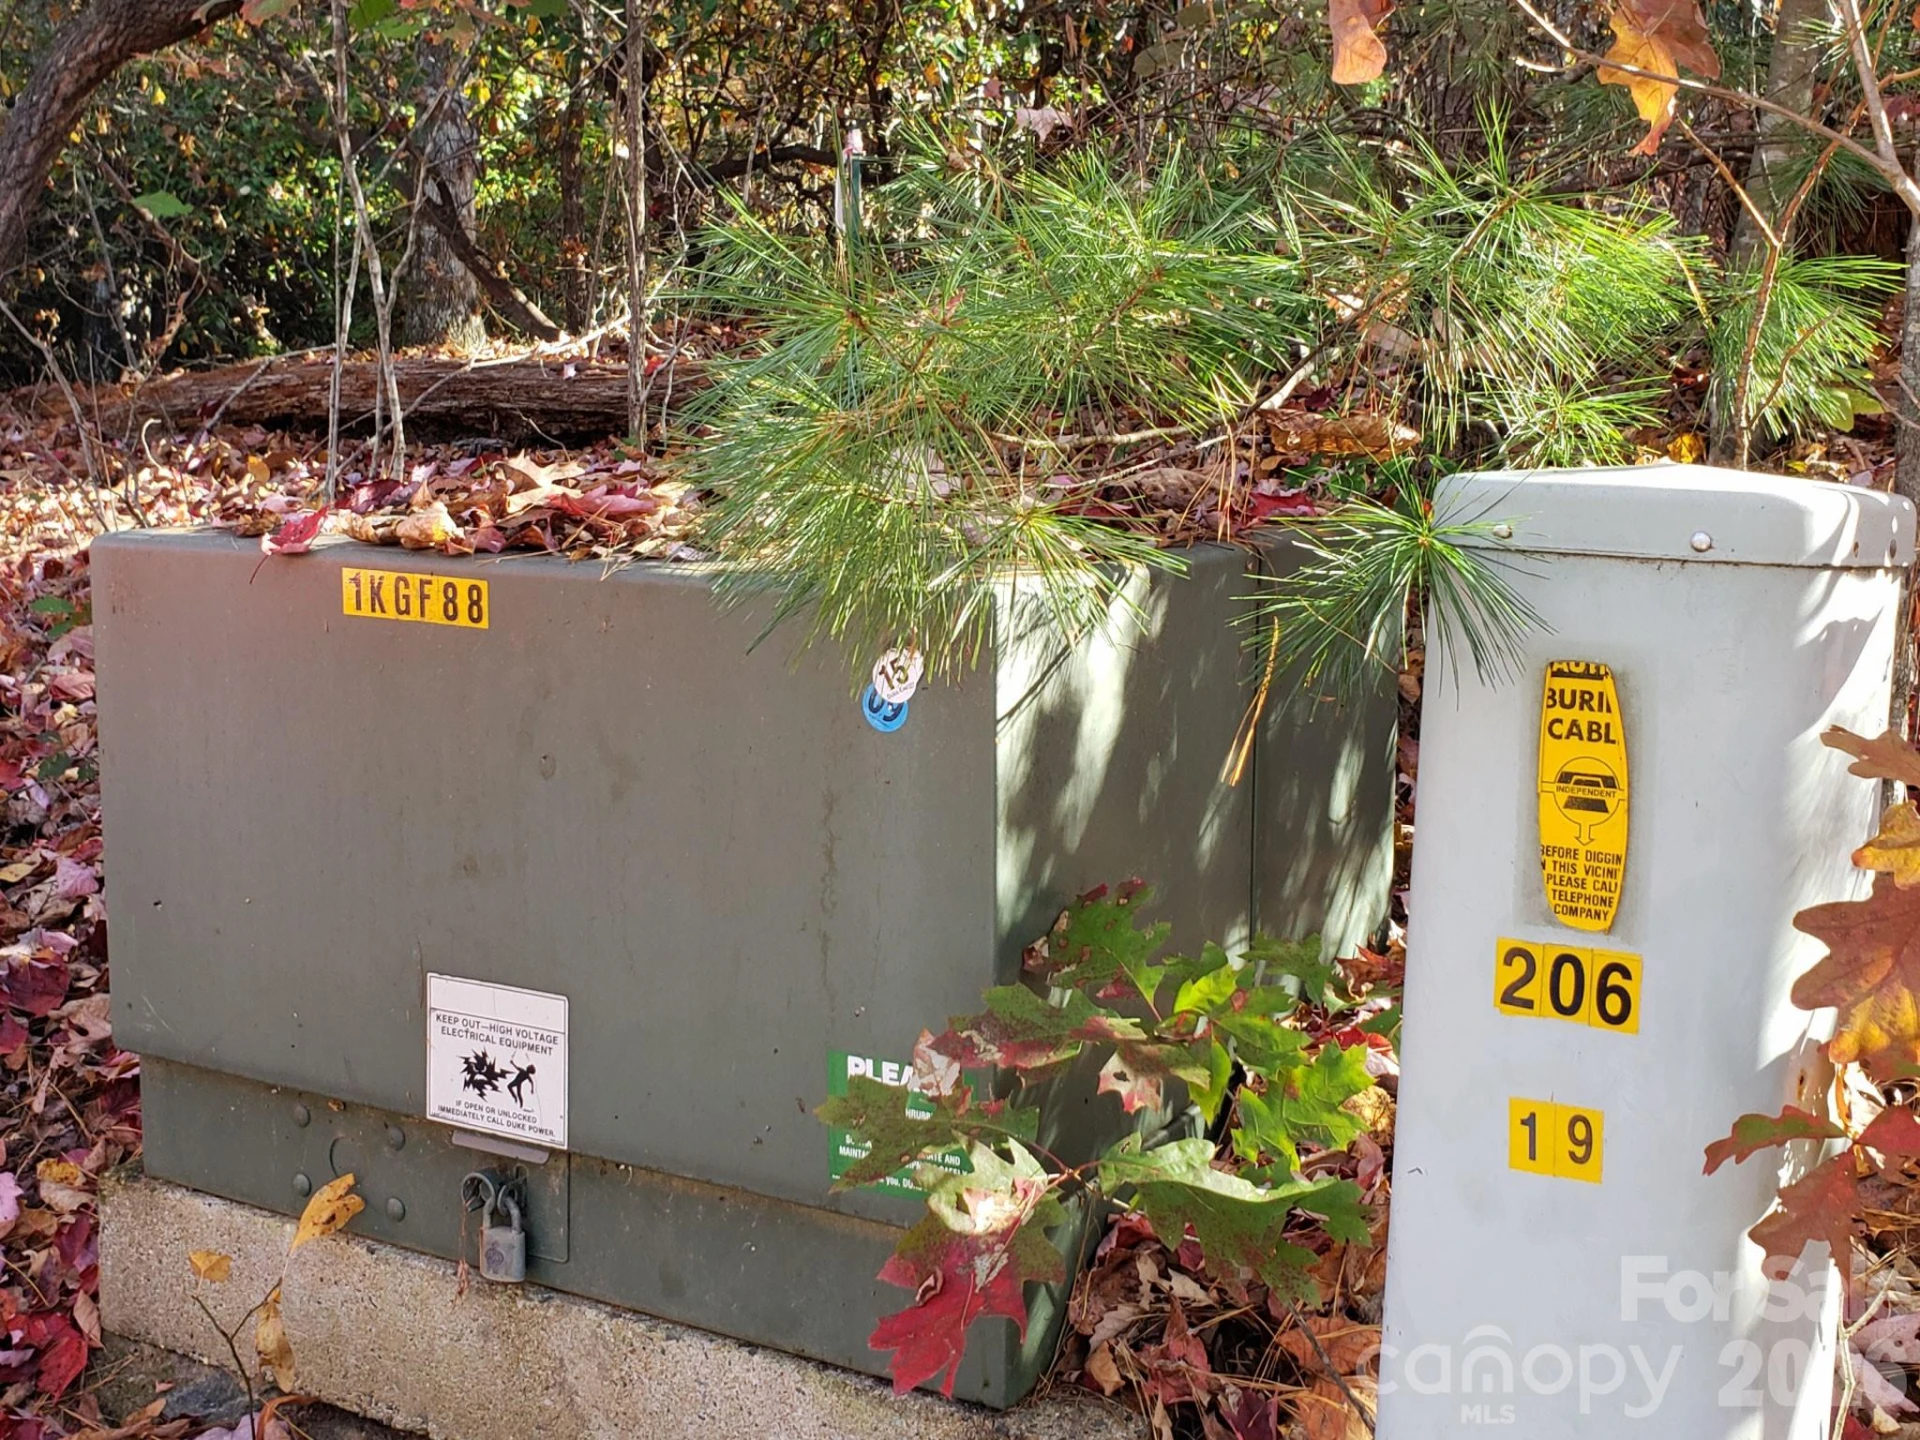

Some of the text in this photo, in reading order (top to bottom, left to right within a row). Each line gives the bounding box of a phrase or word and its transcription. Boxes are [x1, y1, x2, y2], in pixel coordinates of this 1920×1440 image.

[349, 572, 483, 624] 1KGF88
[879, 658, 909, 690] 15
[1555, 785, 1617, 798] INDEPENDENT
[1546, 873, 1587, 889] PLEASE
[1552, 860, 1577, 874] THIS
[1584, 864, 1620, 879] VICINI
[1551, 888, 1614, 908] TELEPHONE
[1553, 903, 1610, 921] COMPANY
[1500, 946, 1633, 1026] 206
[436, 1013, 459, 1025] KEEP
[515, 1028, 559, 1046] VOLTAGE
[441, 1026, 553, 1056] ELECTRICAL EQUIPMENT
[438, 1104, 485, 1121] IMMEDIATELY
[486, 1116, 504, 1126] CALL
[506, 1119, 526, 1131] DUKE
[528, 1125, 556, 1138] POWER.
[464, 1101, 483, 1112] OPEN
[485, 1104, 496, 1114] OR
[498, 1107, 538, 1124] UNLOCKED
[944, 1154, 961, 1166] AND
